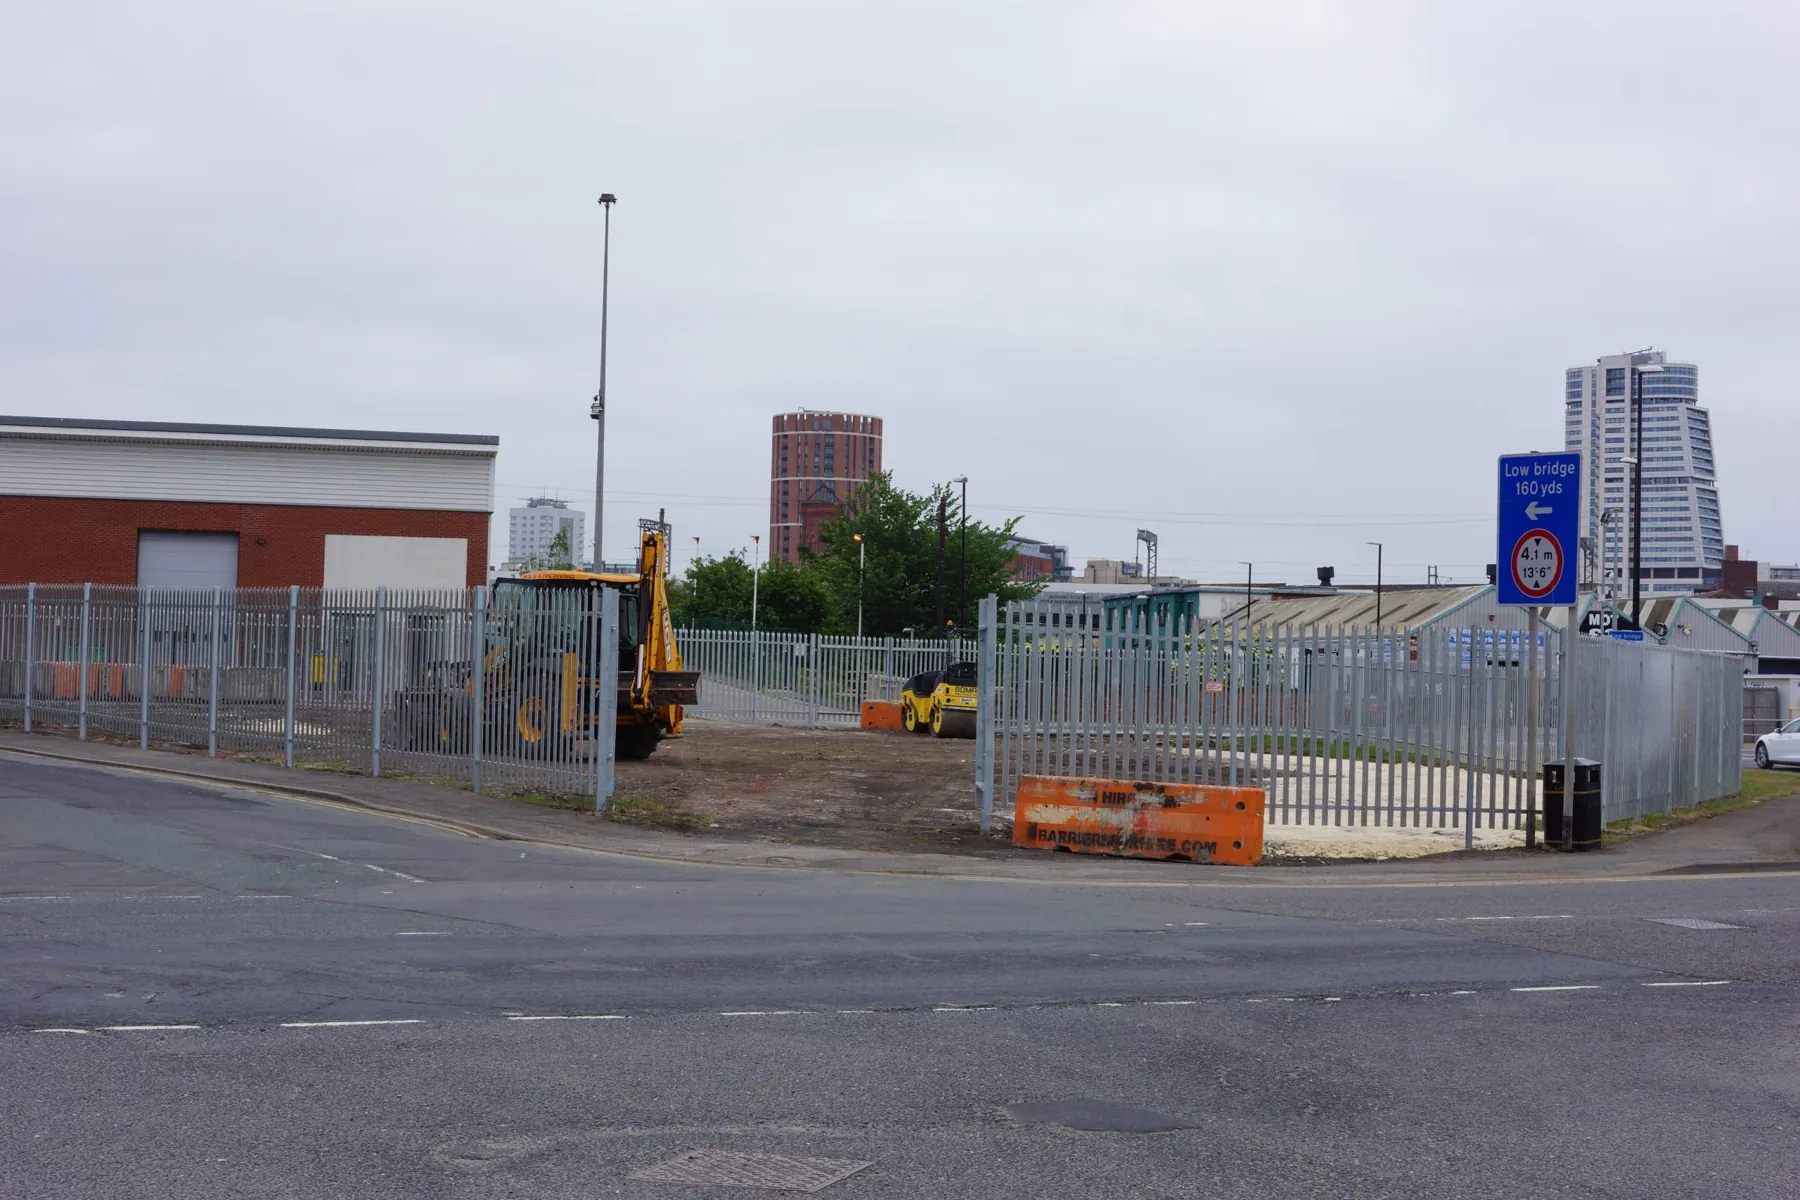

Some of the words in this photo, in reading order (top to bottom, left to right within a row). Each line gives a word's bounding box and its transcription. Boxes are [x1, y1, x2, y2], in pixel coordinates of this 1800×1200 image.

[1504, 463, 1530, 477] Low
[1534, 460, 1575, 478] bridge
[1515, 480, 1539, 496] 160
[1540, 480, 1563, 498] yds
[1520, 547, 1538, 561] 4.1
[1543, 551, 1553, 560] m
[1623, 632, 1642, 640] bridge
[955, 686, 977, 694] BOMA
